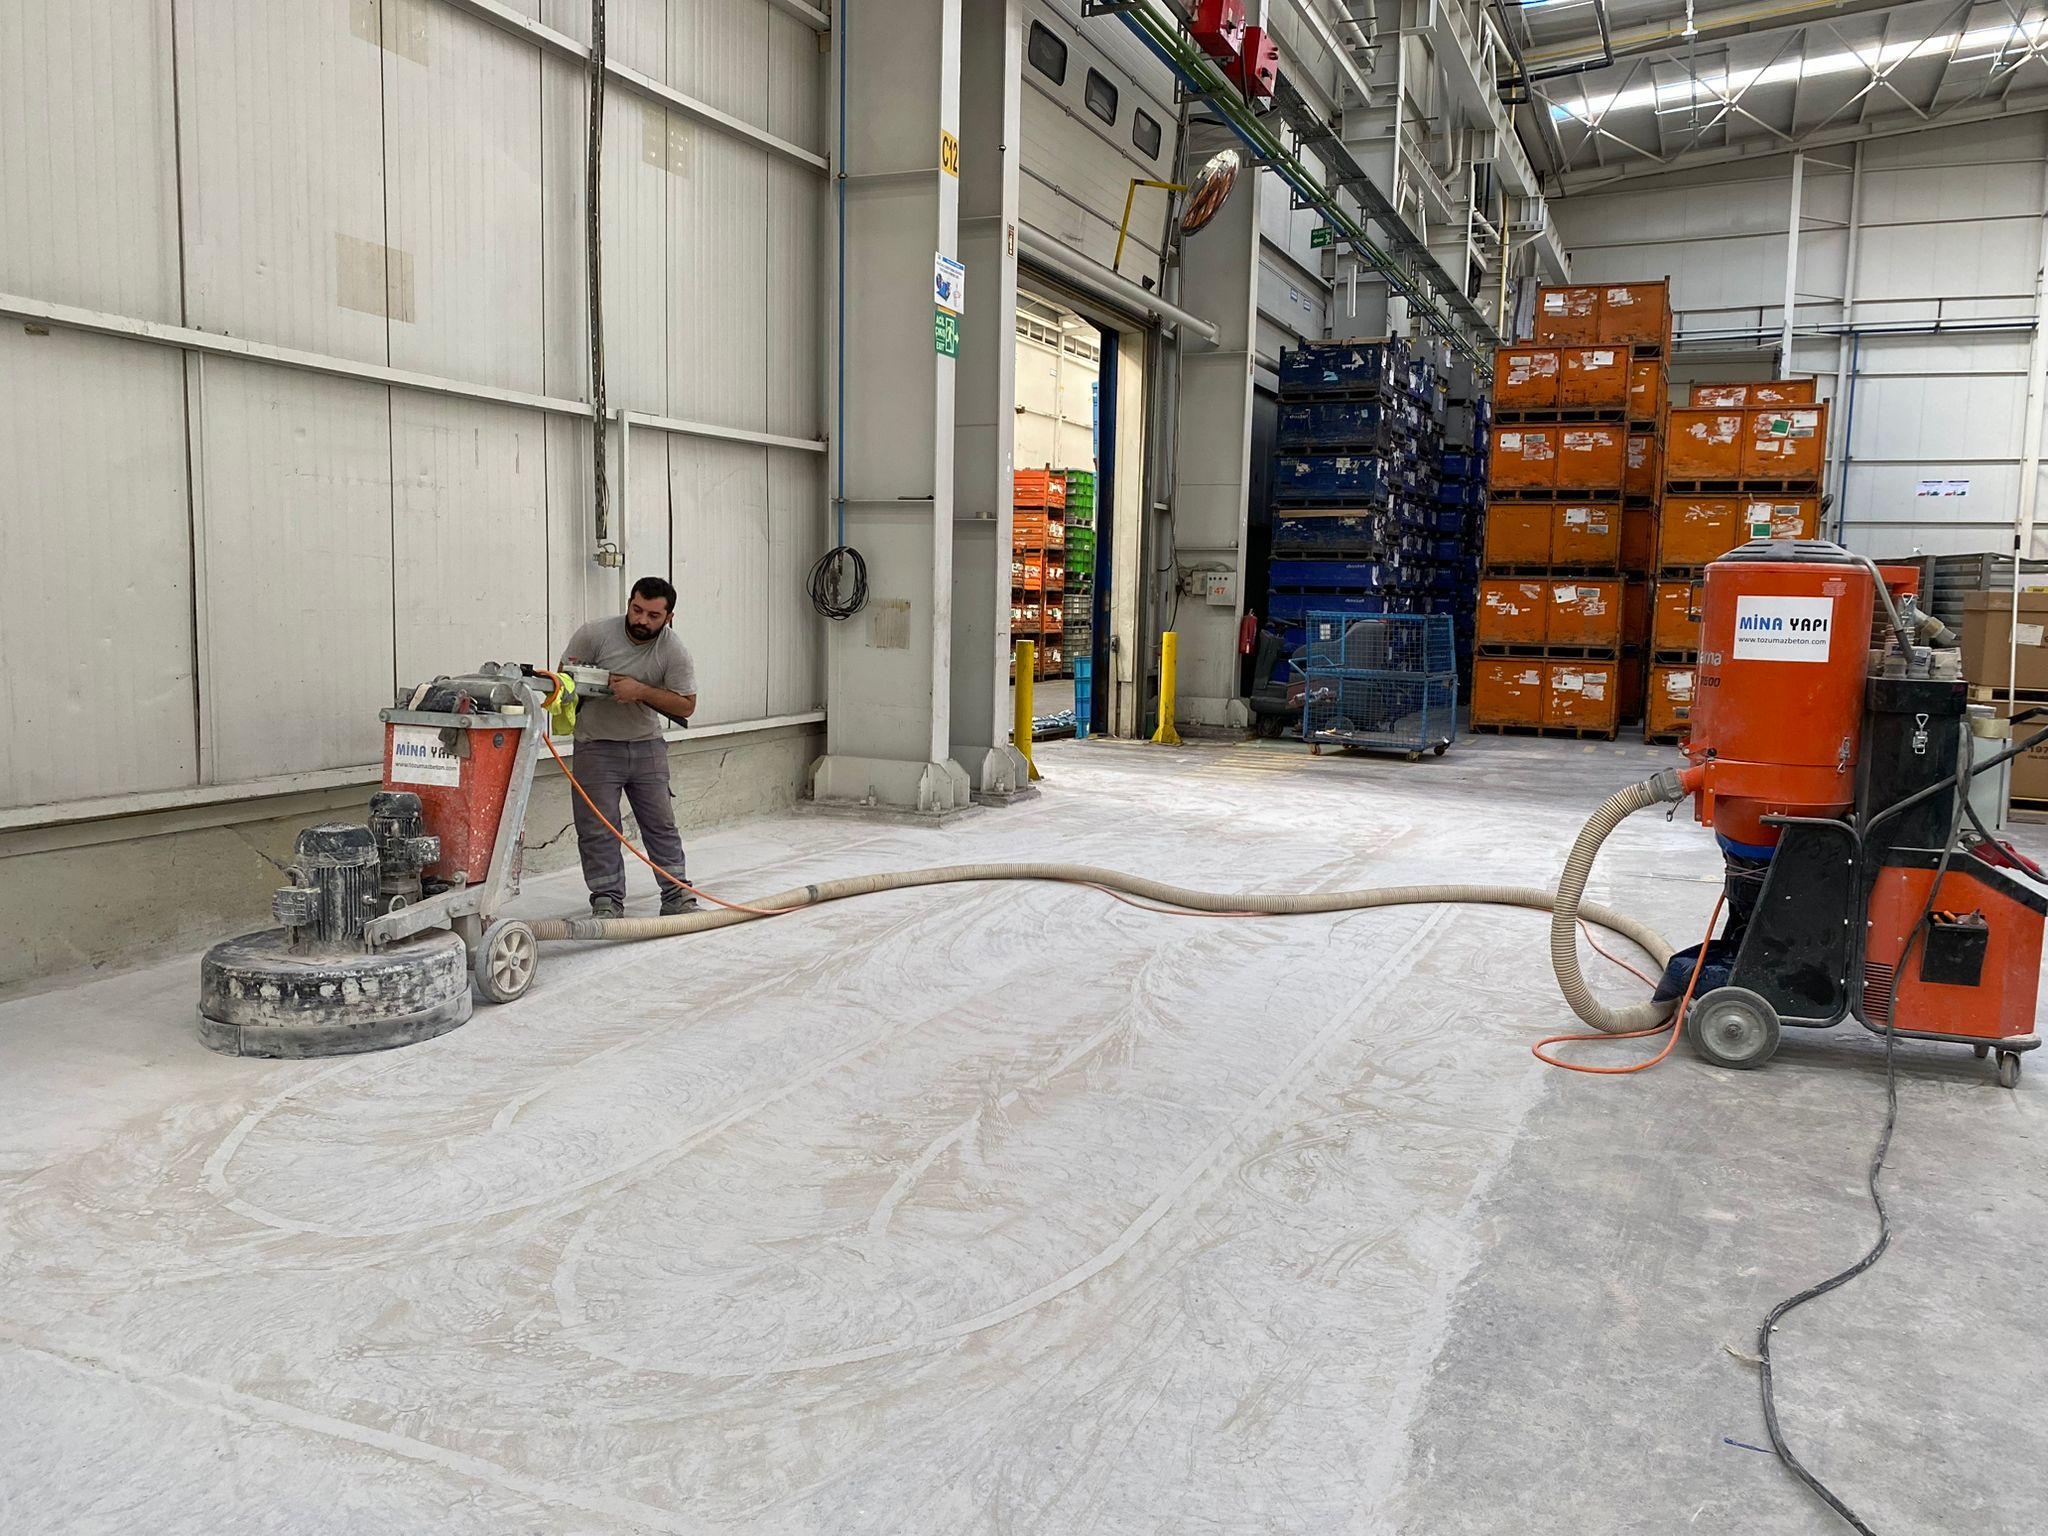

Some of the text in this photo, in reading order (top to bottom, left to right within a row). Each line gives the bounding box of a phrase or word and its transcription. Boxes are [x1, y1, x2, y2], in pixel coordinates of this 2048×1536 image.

[942, 136, 958, 173] C12
[1739, 614, 1828, 632] MİNA YAPI
[1738, 637, 1827, 645] www.tozumazbeton.com
[396, 741, 427, 758] MİNA
